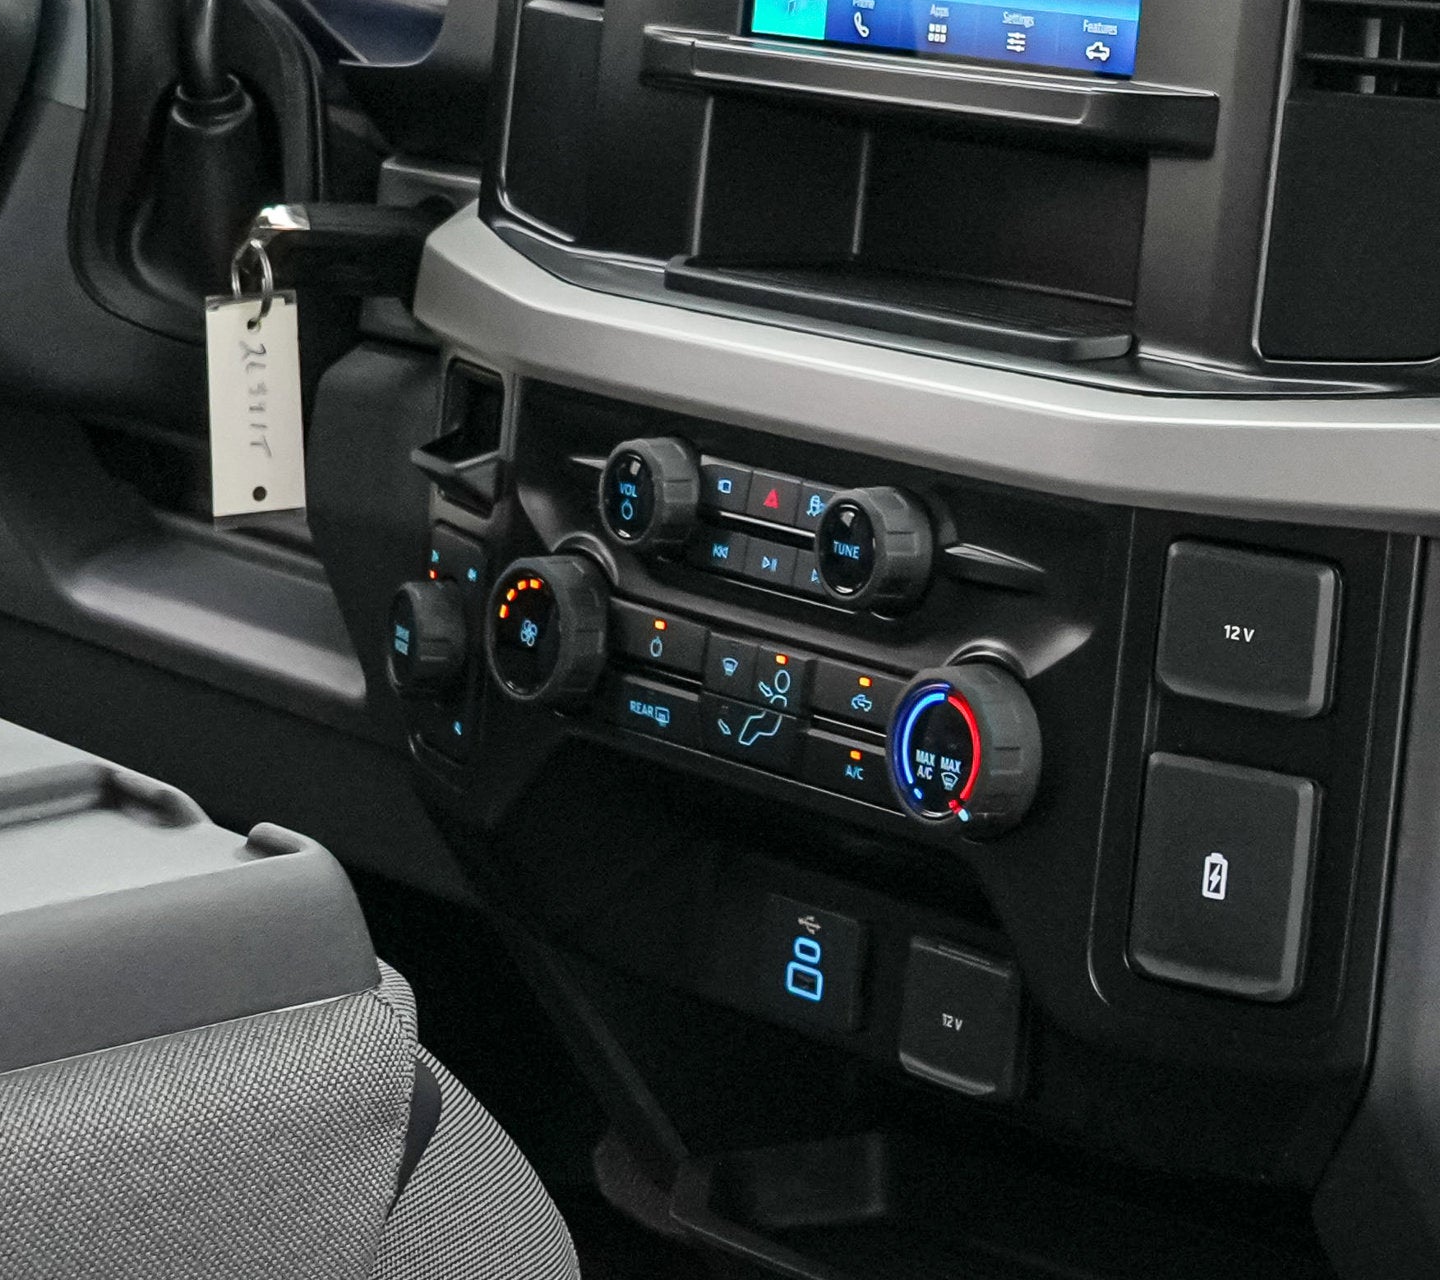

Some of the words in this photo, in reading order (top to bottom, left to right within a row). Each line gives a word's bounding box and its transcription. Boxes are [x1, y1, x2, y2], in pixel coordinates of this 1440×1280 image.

[929, 3, 950, 19] Apps
[1001, 10, 1035, 29] Settings
[1082, 18, 1118, 36] Features
[619, 481, 638, 499] VOL
[832, 539, 861, 561] TUNE
[1223, 624, 1241, 641] 12
[1243, 627, 1256, 643] V
[629, 699, 655, 719] REAR
[915, 748, 936, 768] MAX
[940, 754, 962, 775] MAX
[844, 764, 864, 781] A/C
[915, 764, 934, 781] A/C
[941, 1012, 954, 1028] 12
[954, 1018, 964, 1031] V
